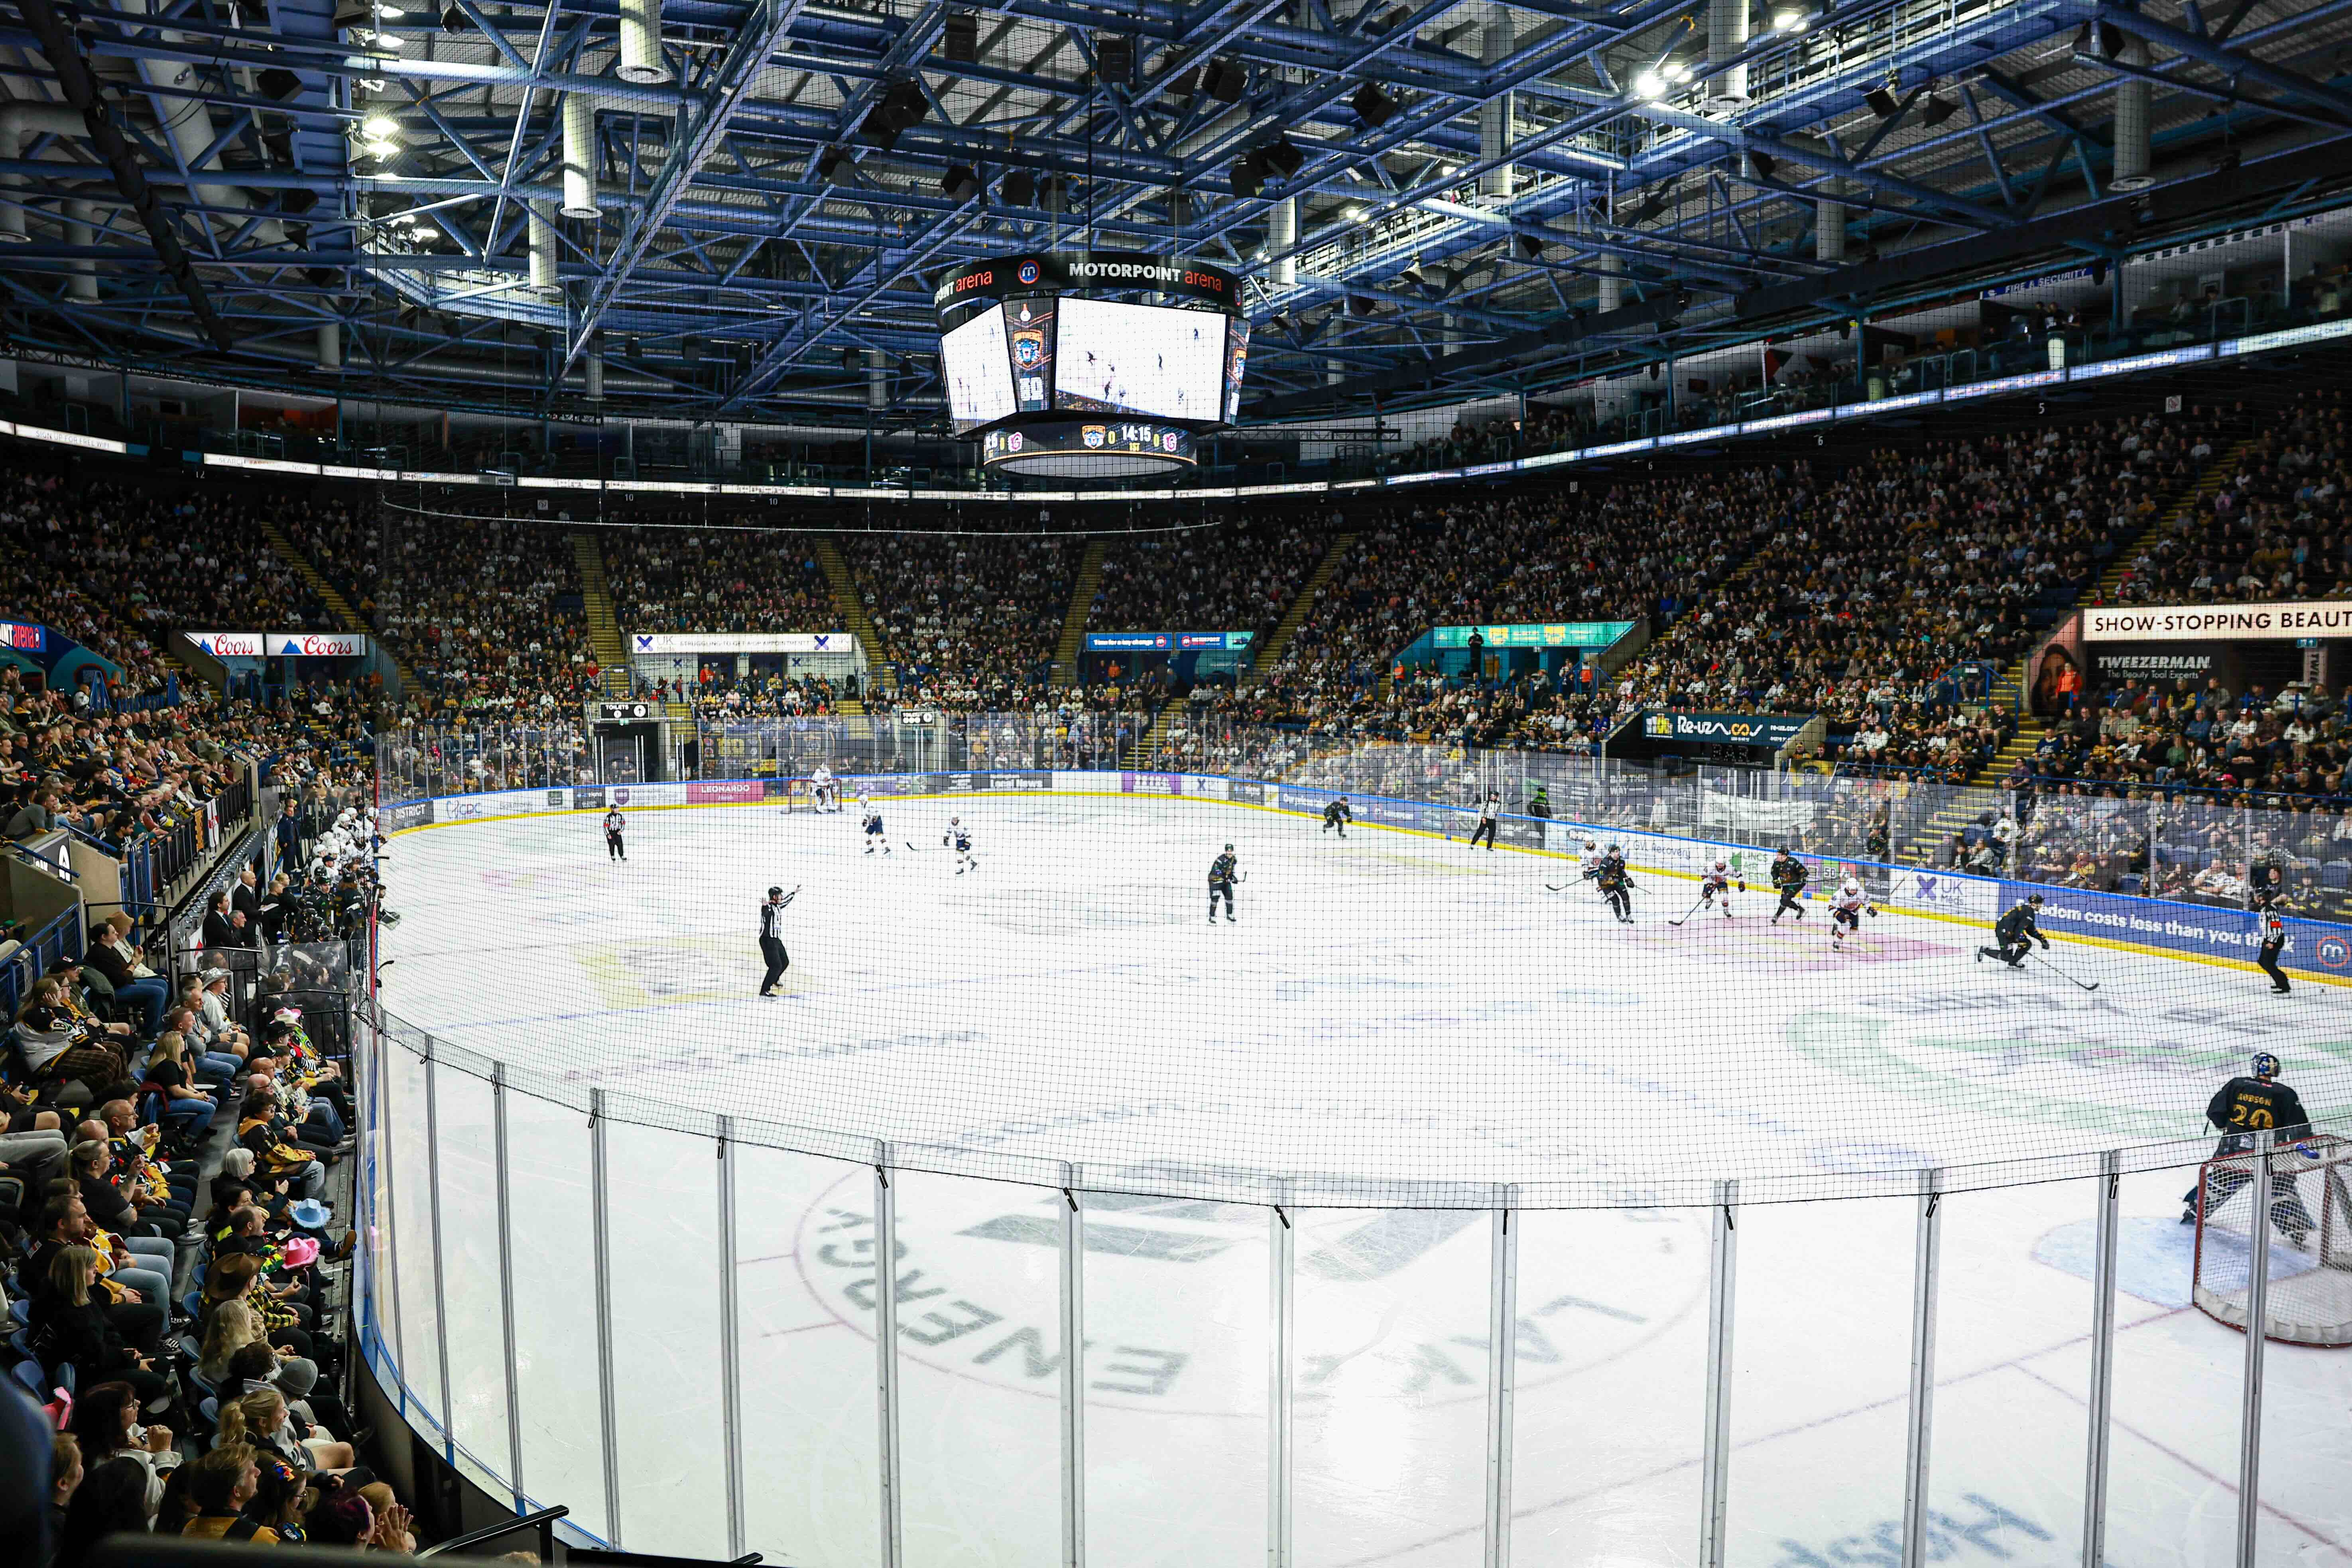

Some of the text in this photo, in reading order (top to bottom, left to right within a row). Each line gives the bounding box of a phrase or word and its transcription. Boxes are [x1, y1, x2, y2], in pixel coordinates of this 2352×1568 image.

[956, 271, 992, 292] arena
[1069, 263, 1222, 291] MOTORPOINT arena
[2005, 282, 2026, 293] FIRE
[2038, 268, 2086, 287] SECURITY
[2038, 403, 2045, 415] 5
[35, 430, 52, 439] SIGN
[64, 435, 77, 444] FOR
[79, 437, 94, 446] FREE
[1108, 431, 1116, 445] 0
[1121, 425, 1151, 442] 14:15
[1129, 443, 1140, 452] 1ST
[218, 457, 246, 466] SEARCH
[2095, 614, 2271, 632] SHOW-STOPPING
[13, 625, 35, 648] arena
[657, 635, 673, 645] UK
[214, 633, 254, 655] Coors
[303, 634, 352, 655] Coors
[2098, 656, 2210, 669] TWEEZERMAN
[2107, 669, 2199, 680] The Beauty Tool Experts
[701, 785, 750, 793] LEONARDO
[990, 778, 1043, 787] Local News
[1610, 785, 1628, 795] WAY
[1633, 840, 1691, 858] GVL Recovery
[1742, 850, 1768, 862] LINCS
[1742, 863, 1757, 872] AIR
[1942, 874, 1964, 895] UK
[1940, 893, 1964, 905] Meds
[2016, 899, 2296, 953] Fedom costs less than you thk
